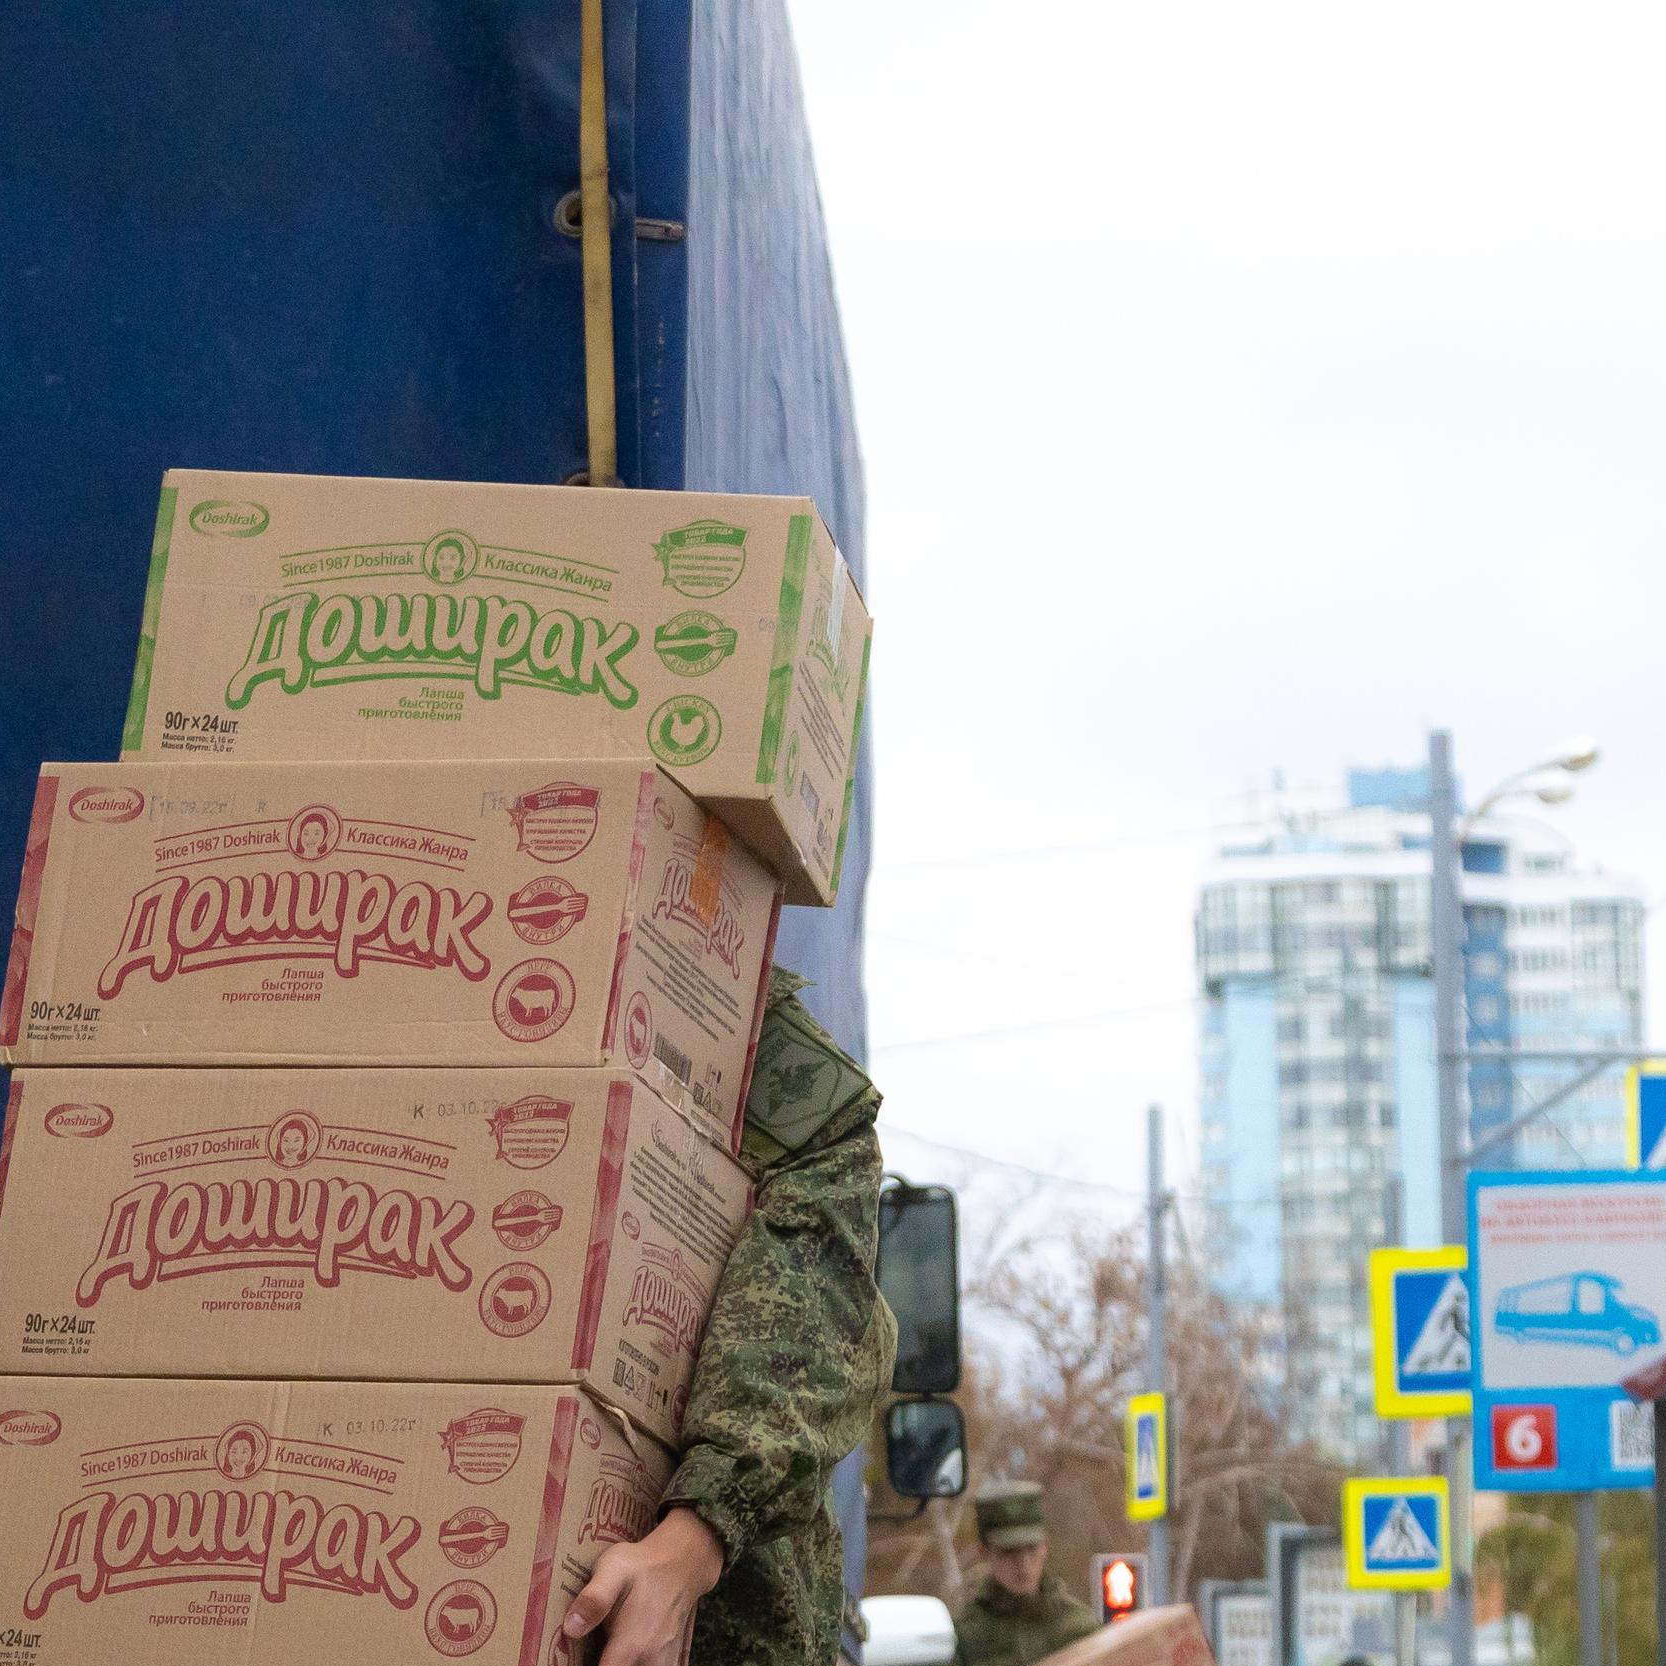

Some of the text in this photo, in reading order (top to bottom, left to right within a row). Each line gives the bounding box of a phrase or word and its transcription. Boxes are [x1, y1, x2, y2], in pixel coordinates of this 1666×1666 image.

[202, 511, 259, 526] Doshirak
[353, 552, 414, 569] Doshirak
[485, 553, 614, 593] Классика Жанра
[226, 592, 640, 709] Доширак
[418, 686, 465, 700] Лапша
[398, 696, 464, 711] быстрого
[357, 707, 463, 722] приготовления
[80, 798, 134, 812] Doshirak
[222, 830, 281, 849] Doshirak
[347, 827, 469, 862] Классика Жанра
[530, 878, 563, 894] ВИЛКА
[97, 869, 493, 1000] Доширак
[522, 923, 566, 942] ВНУТРИ
[281, 968, 325, 980] Лапша
[261, 978, 324, 994] быстрого
[221, 990, 322, 1004] приготовления
[55, 1115, 105, 1127] Doshirak
[201, 1136, 261, 1155] Doshirak
[326, 1134, 450, 1171] Классика Жанра
[75, 1177, 474, 1308] Доширак
[260, 1275, 305, 1289] Лапша
[241, 1287, 304, 1302] быстрого
[201, 1299, 302, 1313] приготовления
[3, 1421, 53, 1434] Doshirak
[1504, 1413, 1544, 1463] 6
[149, 1448, 209, 1465] Doshirak
[275, 1446, 398, 1484] Классика Жанра
[23, 1490, 421, 1621] Доширак
[206, 1590, 252, 1604] Лапша
[187, 1601, 251, 1617] быстрого
[148, 1613, 249, 1627] приготовления
